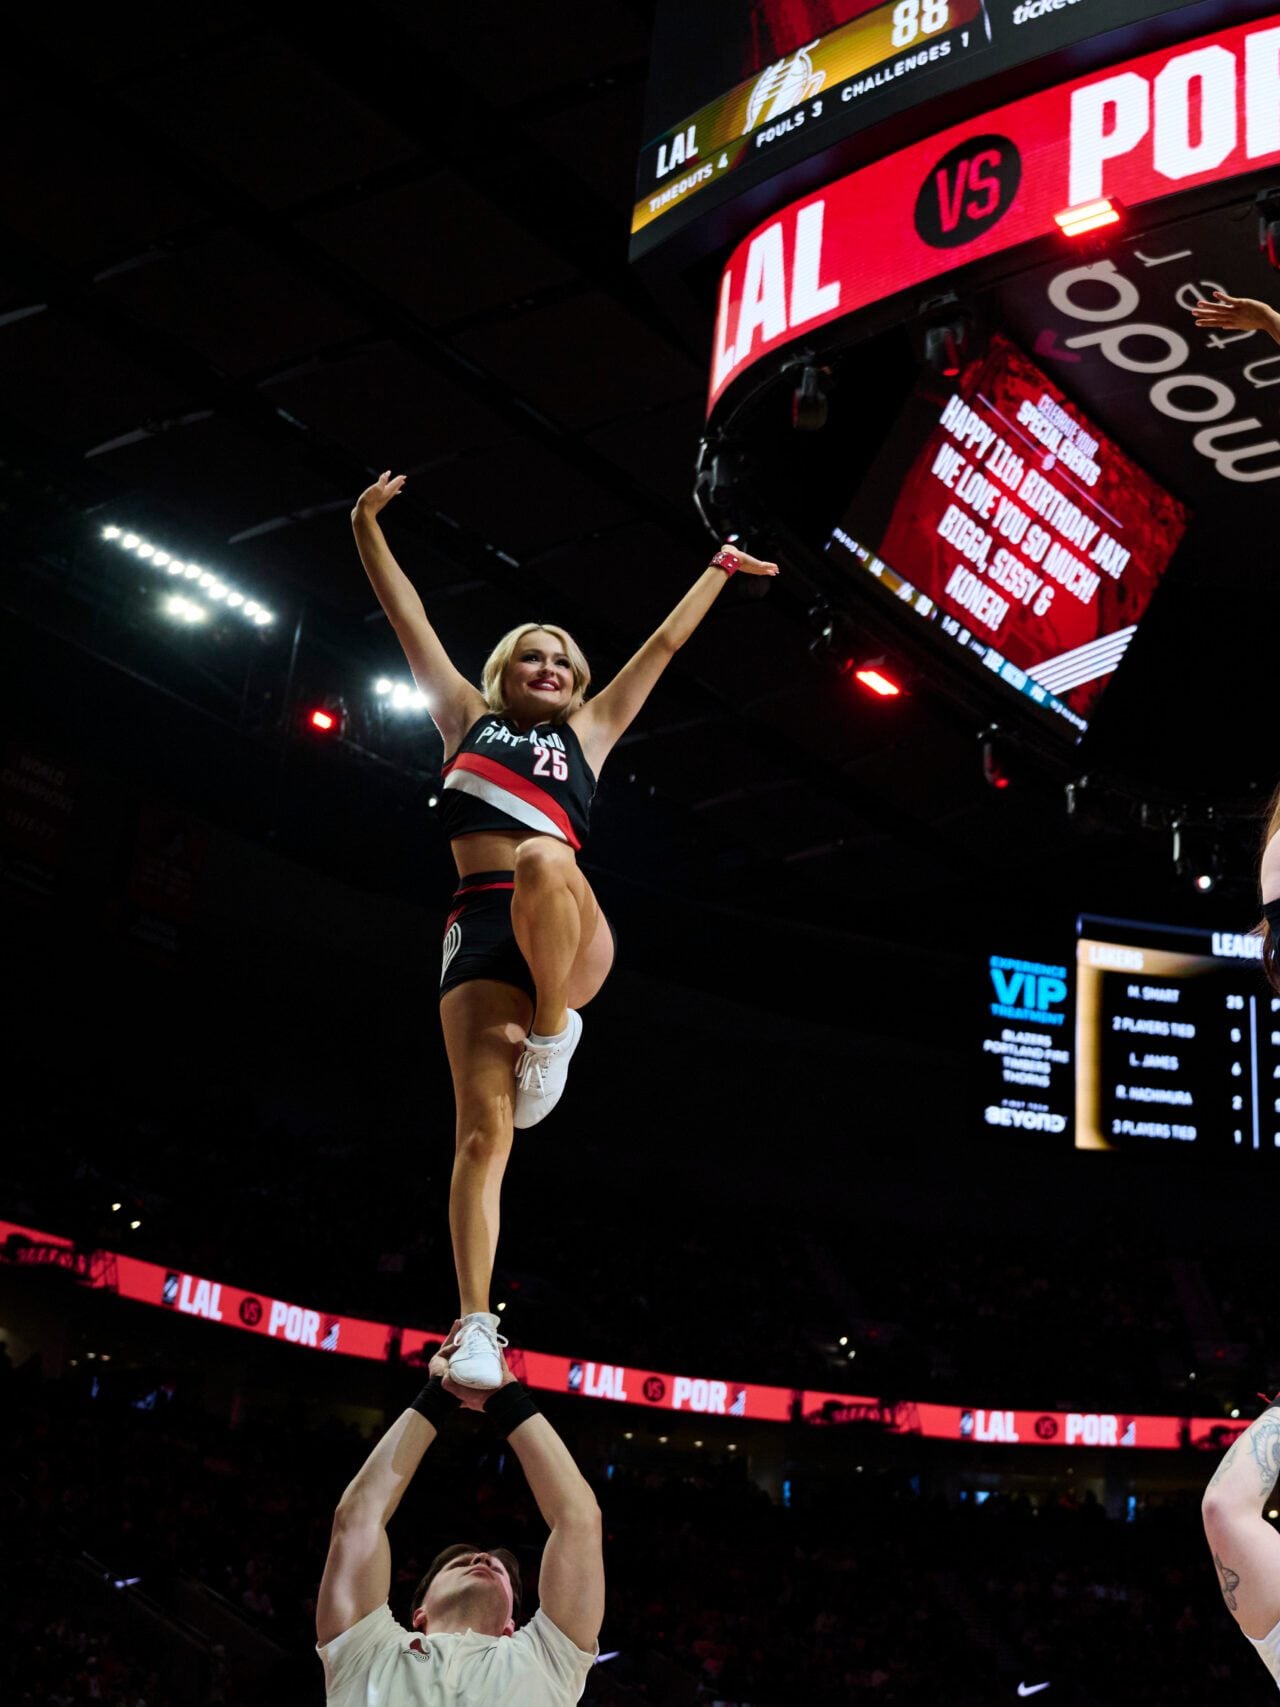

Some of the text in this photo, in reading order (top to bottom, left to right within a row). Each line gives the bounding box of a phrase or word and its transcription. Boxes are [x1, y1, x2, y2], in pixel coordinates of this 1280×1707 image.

[649, 32, 969, 213] TIMEOUTS 4 FOULS 3 CHALLENGES 1
[656, 125, 698, 178] LAL
[711, 199, 841, 394] LAL
[936, 149, 1001, 233] VS
[1016, 399, 1101, 487] SPECIAL EVENTS
[939, 394, 1131, 580] HAPPY 11th BIRTHDAY JAX!
[931, 442, 1101, 605] WE LOVE YOU SO MUCH!
[937, 503, 993, 573] BIGGA,
[988, 548, 1044, 605] SISSY
[1033, 585, 1055, 617] &
[945, 564, 1010, 632] KONER!
[533, 746, 568, 782] 25
[990, 956, 1067, 979] EXPERIENCE
[1088, 946, 1144, 970] LAKERS
[990, 968, 1067, 1010] VIP
[1142, 986, 1180, 1003] SMART
[990, 1003, 1065, 1025] TREATMENT
[1121, 1017, 1170, 1037] PLAYERS
[1170, 1022, 1196, 1039] TIED
[983, 1040, 1044, 1061] PORTLAND
[1002, 1029, 1052, 1047] BLAZERS
[1003, 1069, 1050, 1088] THORNS
[1129, 1087, 1193, 1106] HACHIMURA
[985, 1105, 1066, 1133] BEYOND
[1121, 1120, 1171, 1140] PLAYERS
[1171, 1125, 1197, 1141] TIED
[178, 1275, 320, 1347] LAL VS POR
[582, 1364, 727, 1415] LAL VS POR
[975, 1409, 1118, 1446] LAL VS POR
